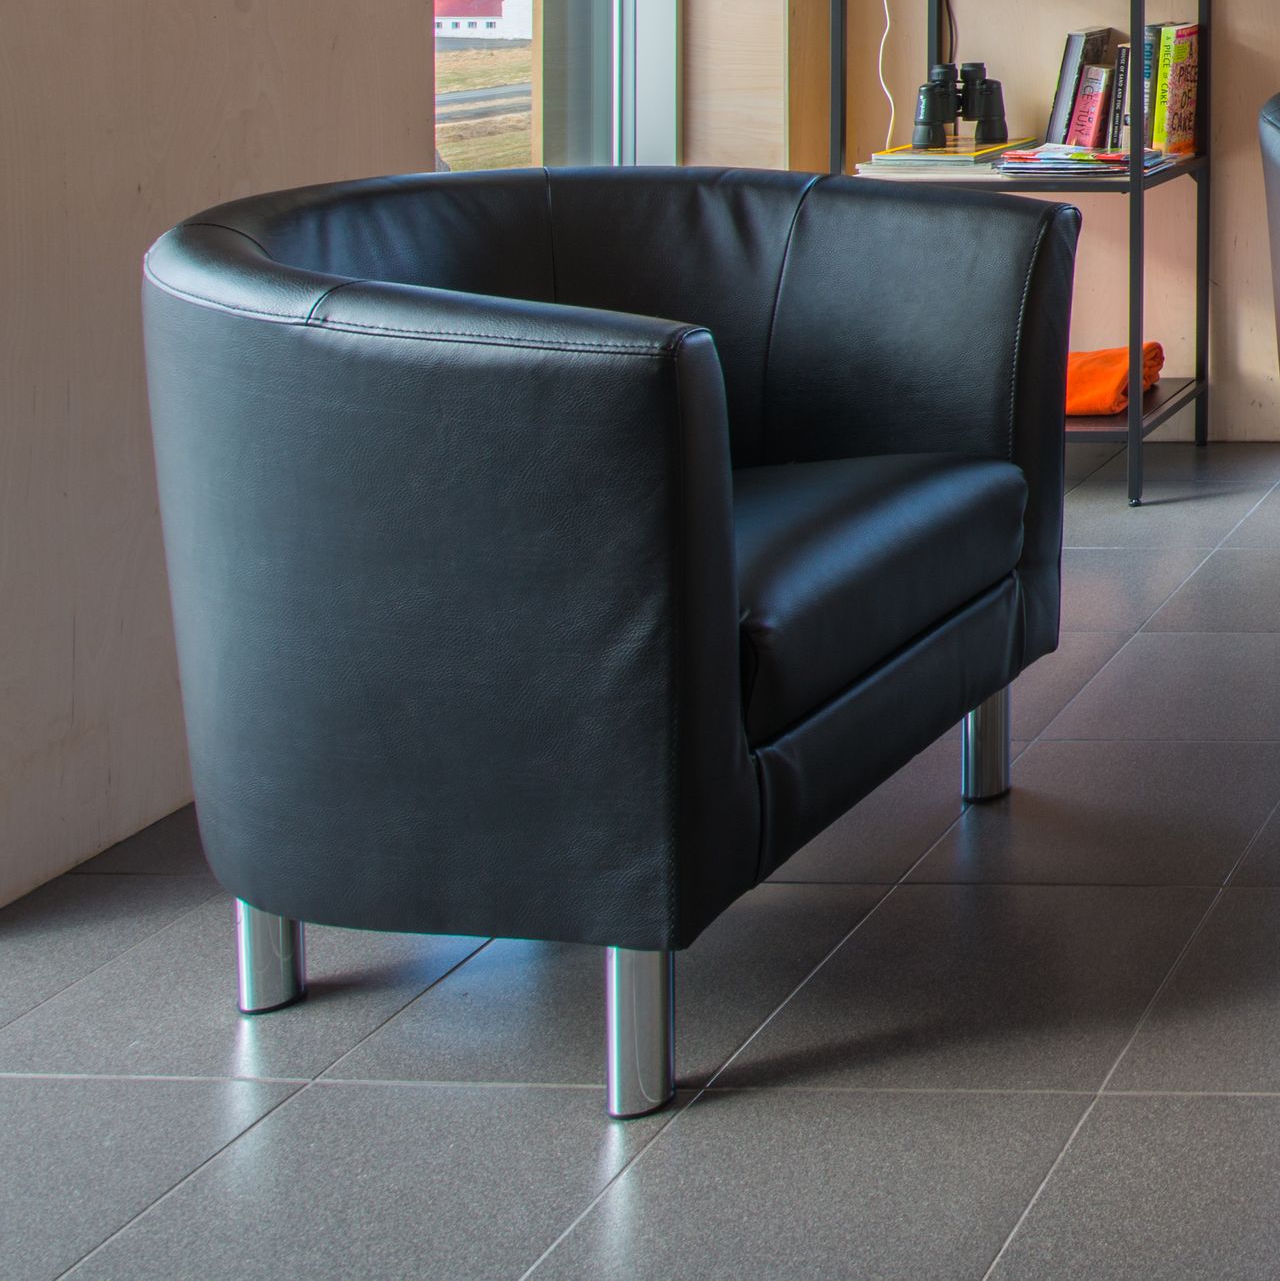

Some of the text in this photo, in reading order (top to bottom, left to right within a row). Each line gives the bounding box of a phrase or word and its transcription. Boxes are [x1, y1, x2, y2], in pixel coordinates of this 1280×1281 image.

[1119, 48, 1127, 64] HOUSE
[1163, 45, 1171, 68] PIECE
[1119, 65, 1125, 73] OF
[1160, 83, 1169, 106] CAKE
[1181, 88, 1192, 109] OF
[1171, 113, 1194, 132] CAKE
